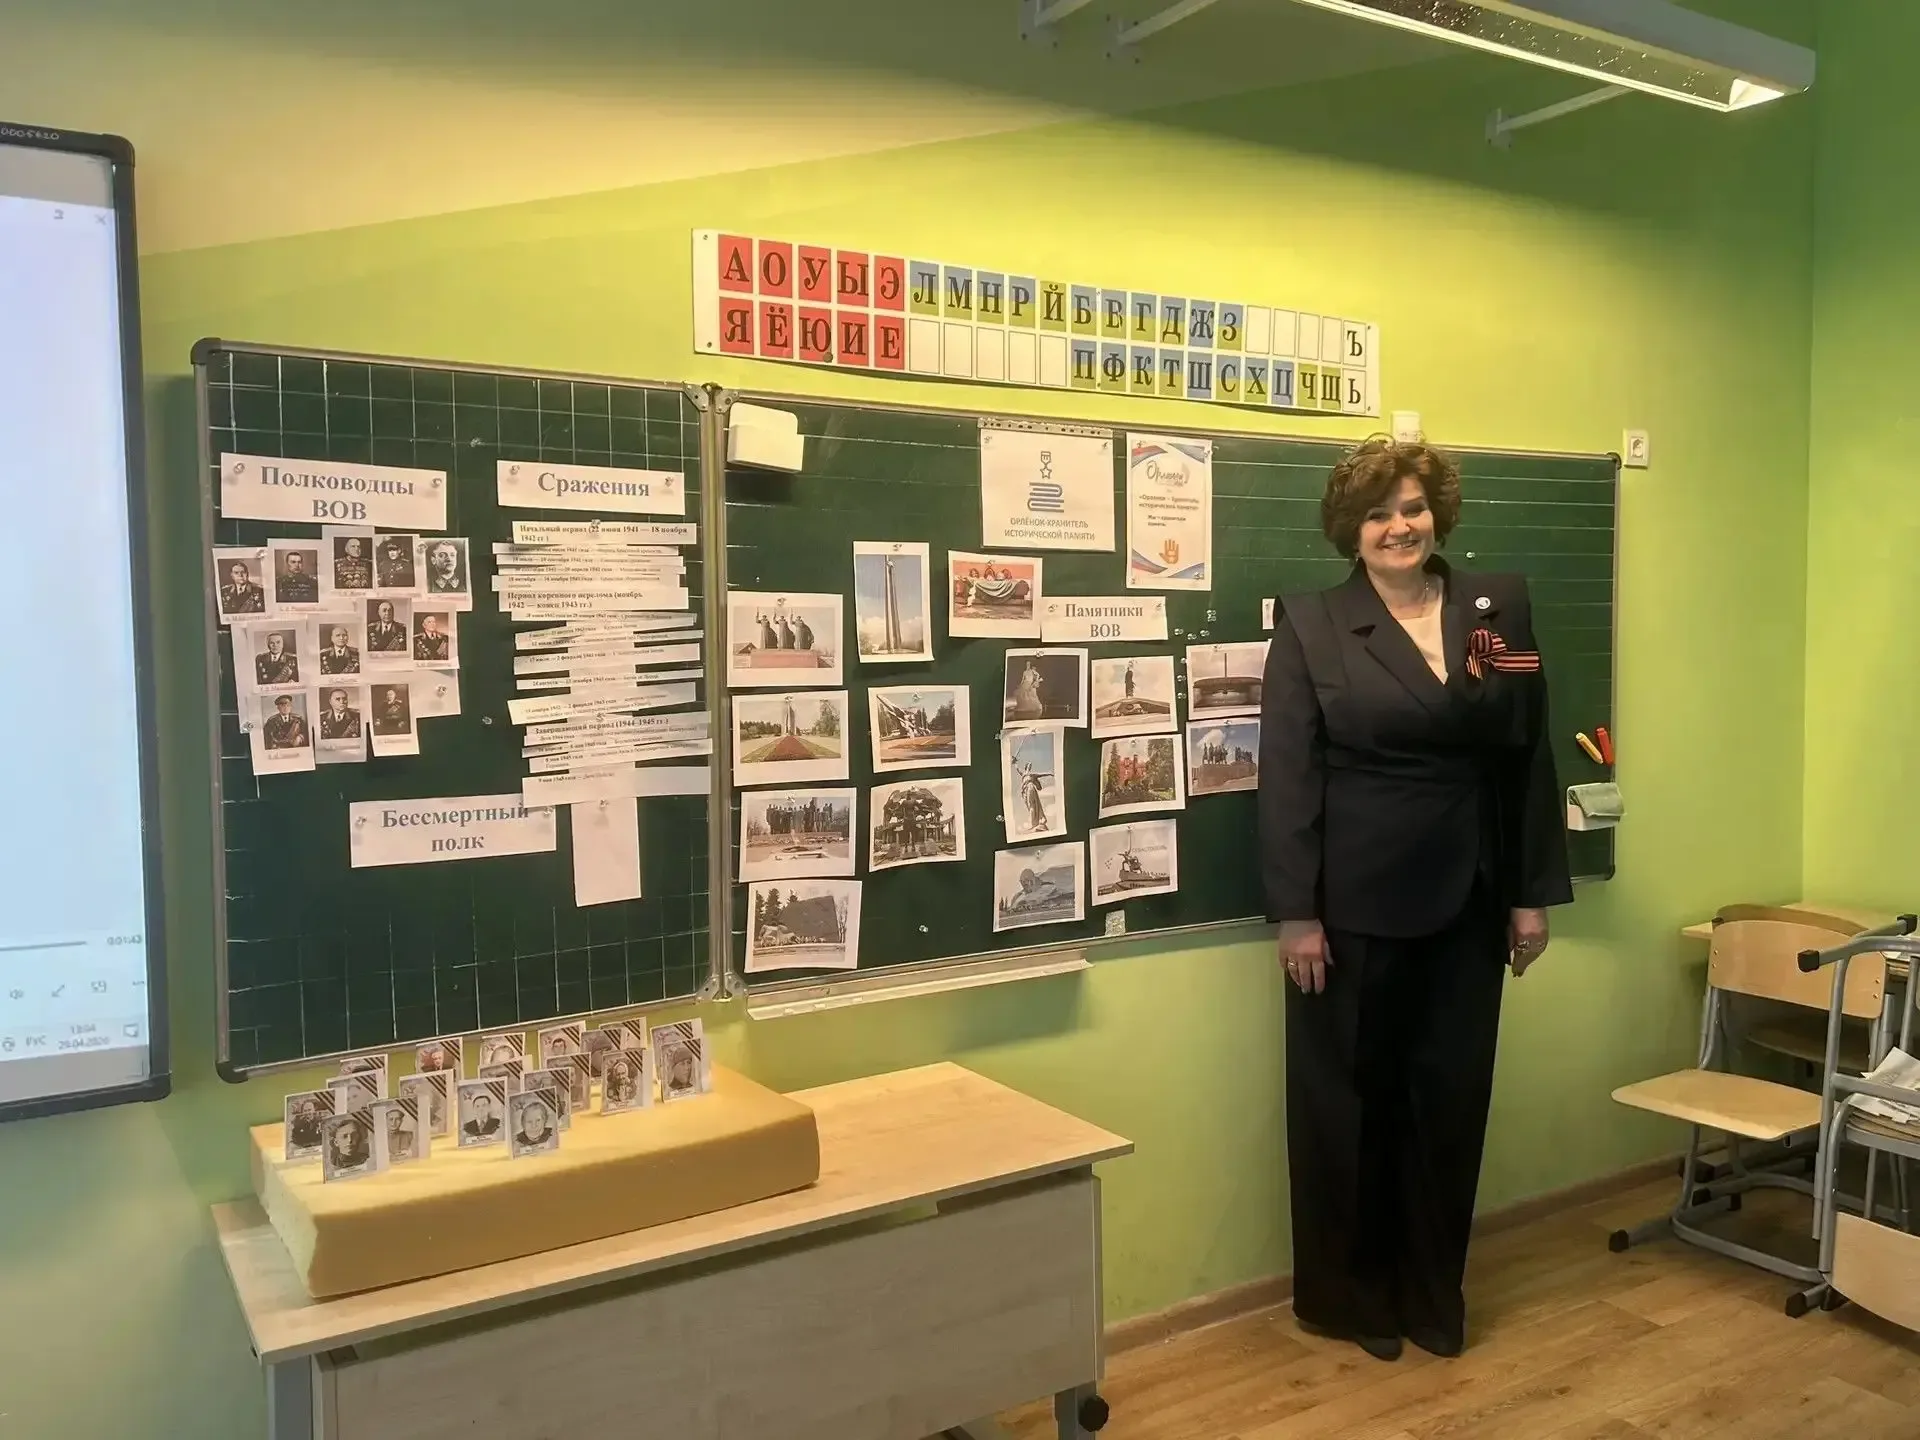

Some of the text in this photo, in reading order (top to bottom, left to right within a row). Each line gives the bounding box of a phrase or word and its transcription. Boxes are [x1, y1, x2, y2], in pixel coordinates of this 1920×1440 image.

[723, 247, 1363, 357] А О У Ы Э Л М Н Р Й Б В Г Д Ж З Ъ
[724, 306, 1361, 409] Я Ё Ю И Е П Ф К Т Ш С Х Ц Ч Щ Ь
[260, 465, 414, 495] Полководцы
[537, 472, 650, 497] Сражения
[312, 499, 367, 520] ВОВ
[520, 524, 561, 533] Начальный
[562, 527, 587, 535] период
[661, 526, 688, 535] ноября
[1004, 529, 1095, 541] ИСТОРИЧЕСКОЙ ПАМЯТИ
[521, 534, 536, 542] 1942
[507, 591, 643, 601] Период коренного перелома (ноябрь
[508, 601, 525, 609] 1942
[1065, 603, 1143, 617] Памятники
[1090, 623, 1121, 637] ВОВ
[588, 721, 614, 730] период
[381, 802, 529, 829] Бессмертный
[431, 834, 485, 853] полк
